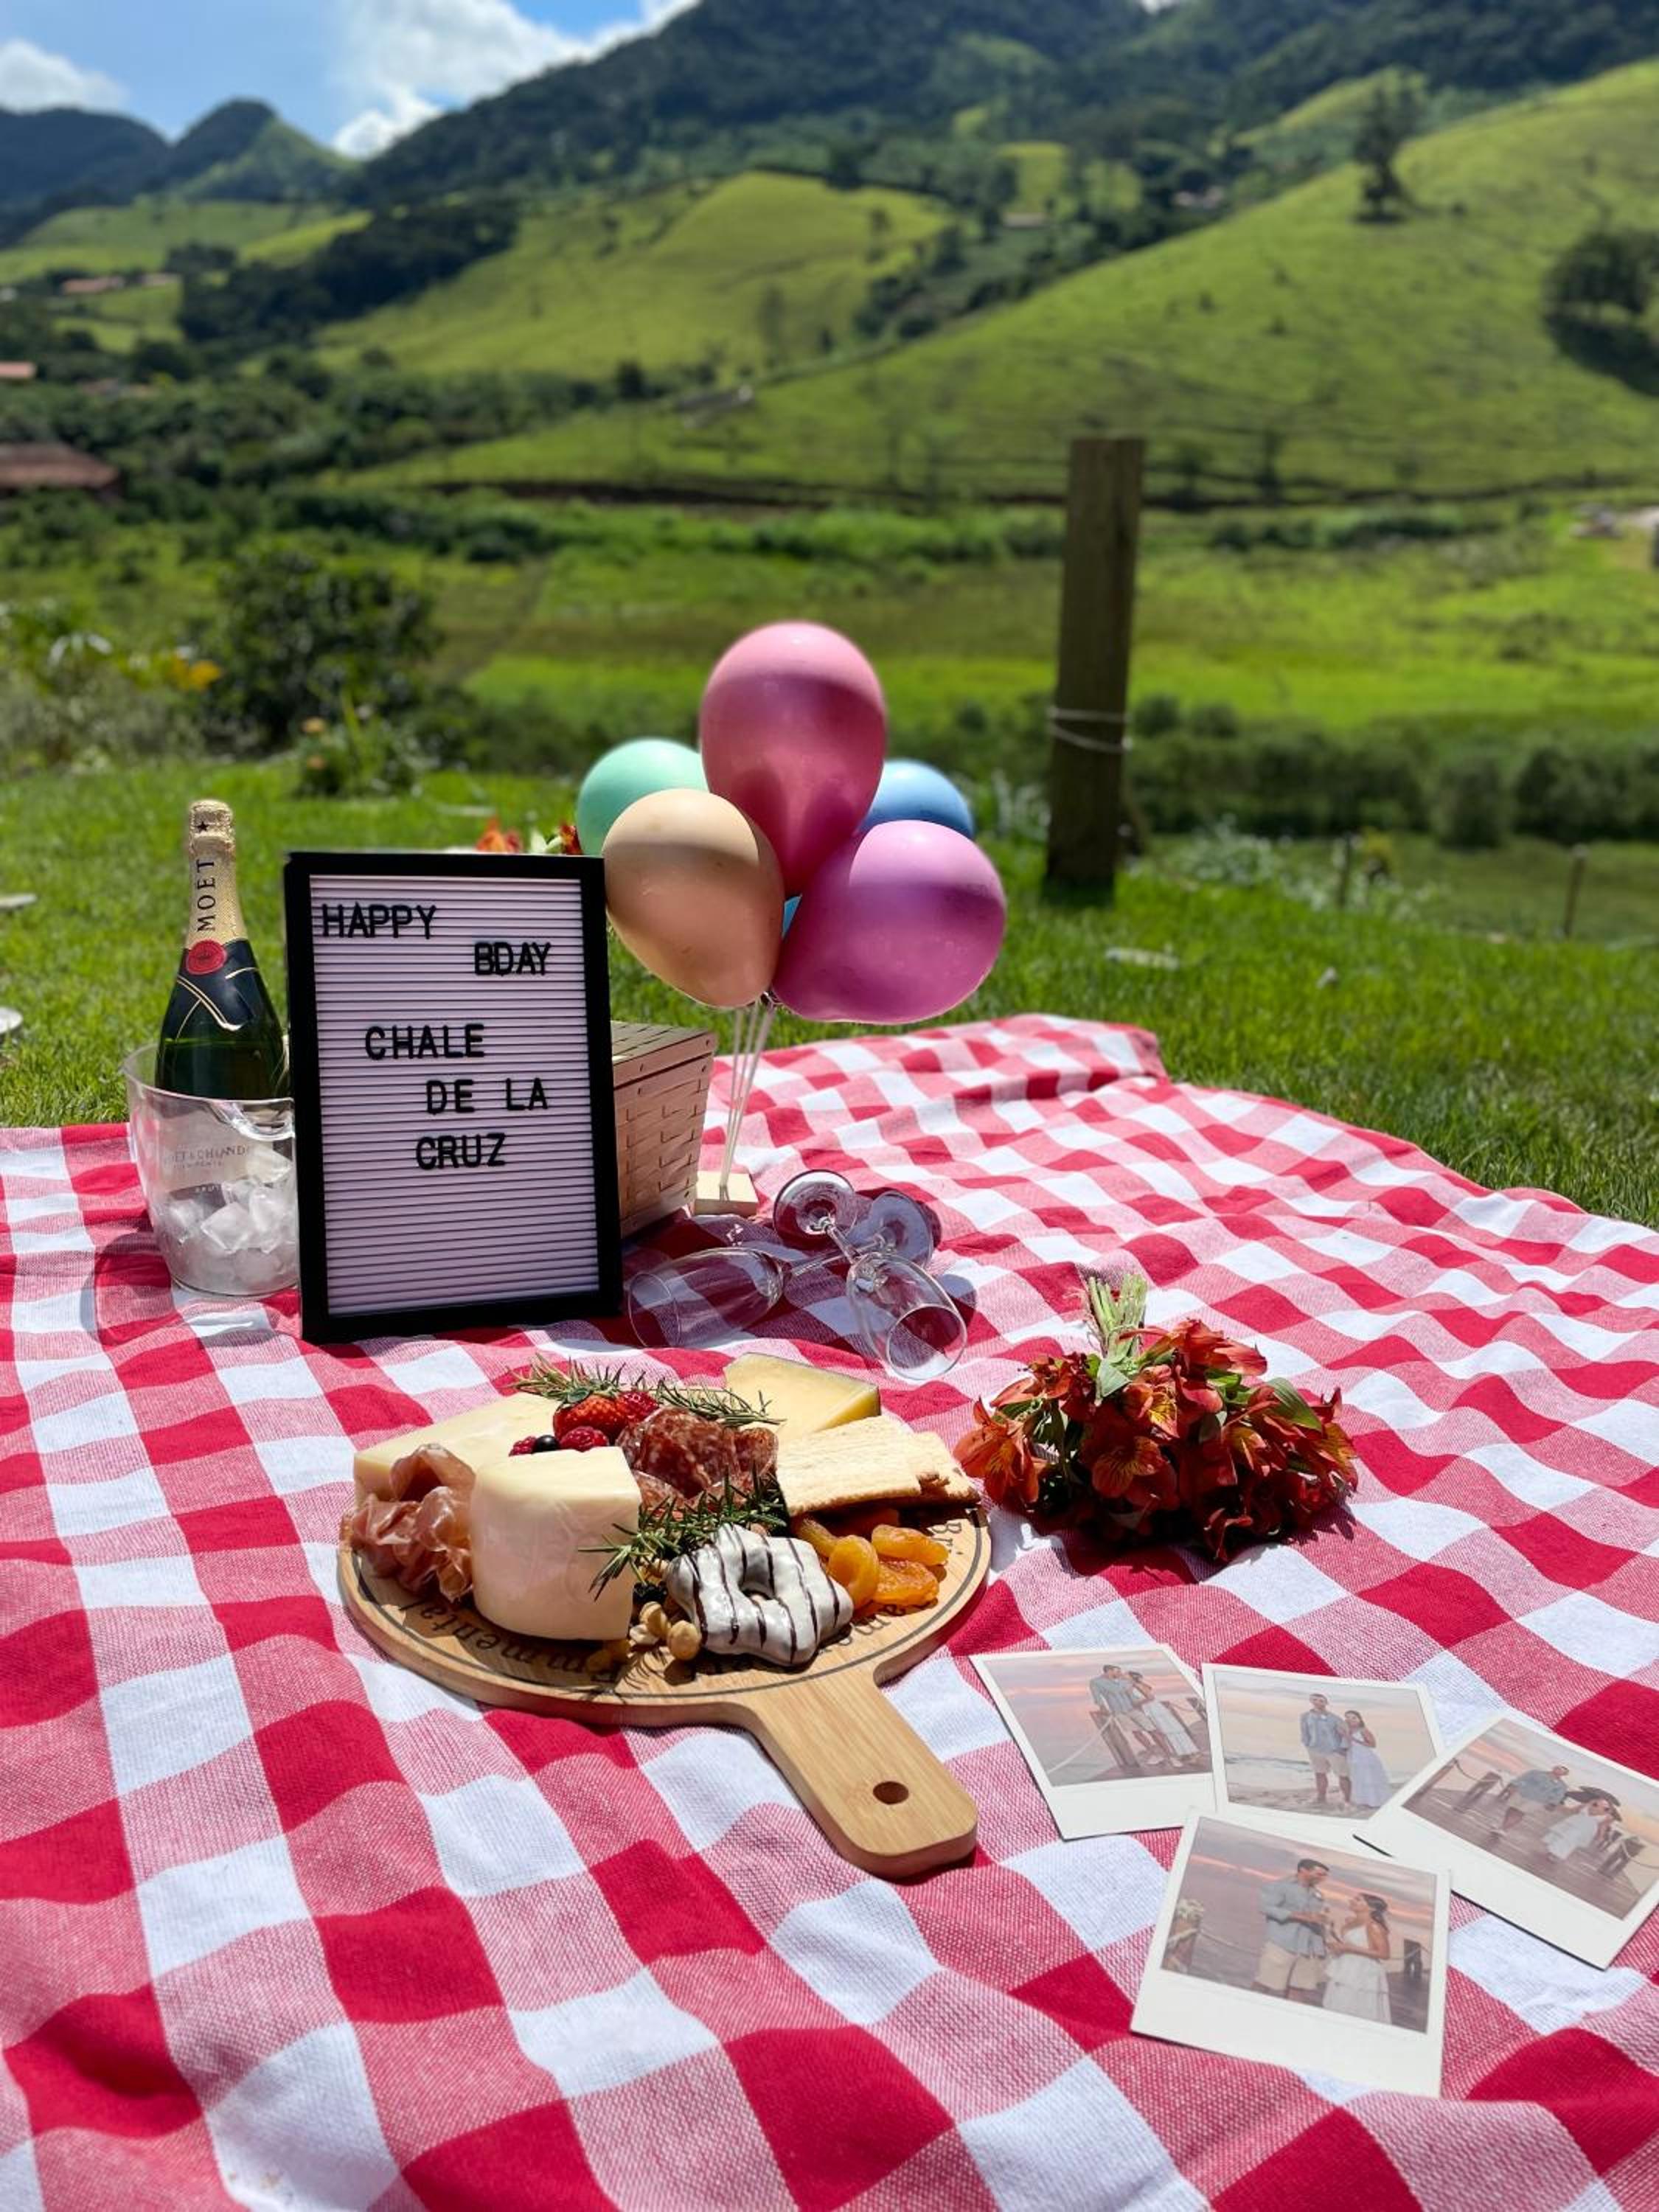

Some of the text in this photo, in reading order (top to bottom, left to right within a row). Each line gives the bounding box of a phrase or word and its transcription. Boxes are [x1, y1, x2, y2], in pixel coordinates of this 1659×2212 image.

[321, 902, 437, 939] HAPPY
[474, 942, 552, 976] BDAY
[365, 1023, 484, 1060] CHALE
[426, 1078, 549, 1115] DE LA
[416, 1133, 506, 1170] CRUZ
